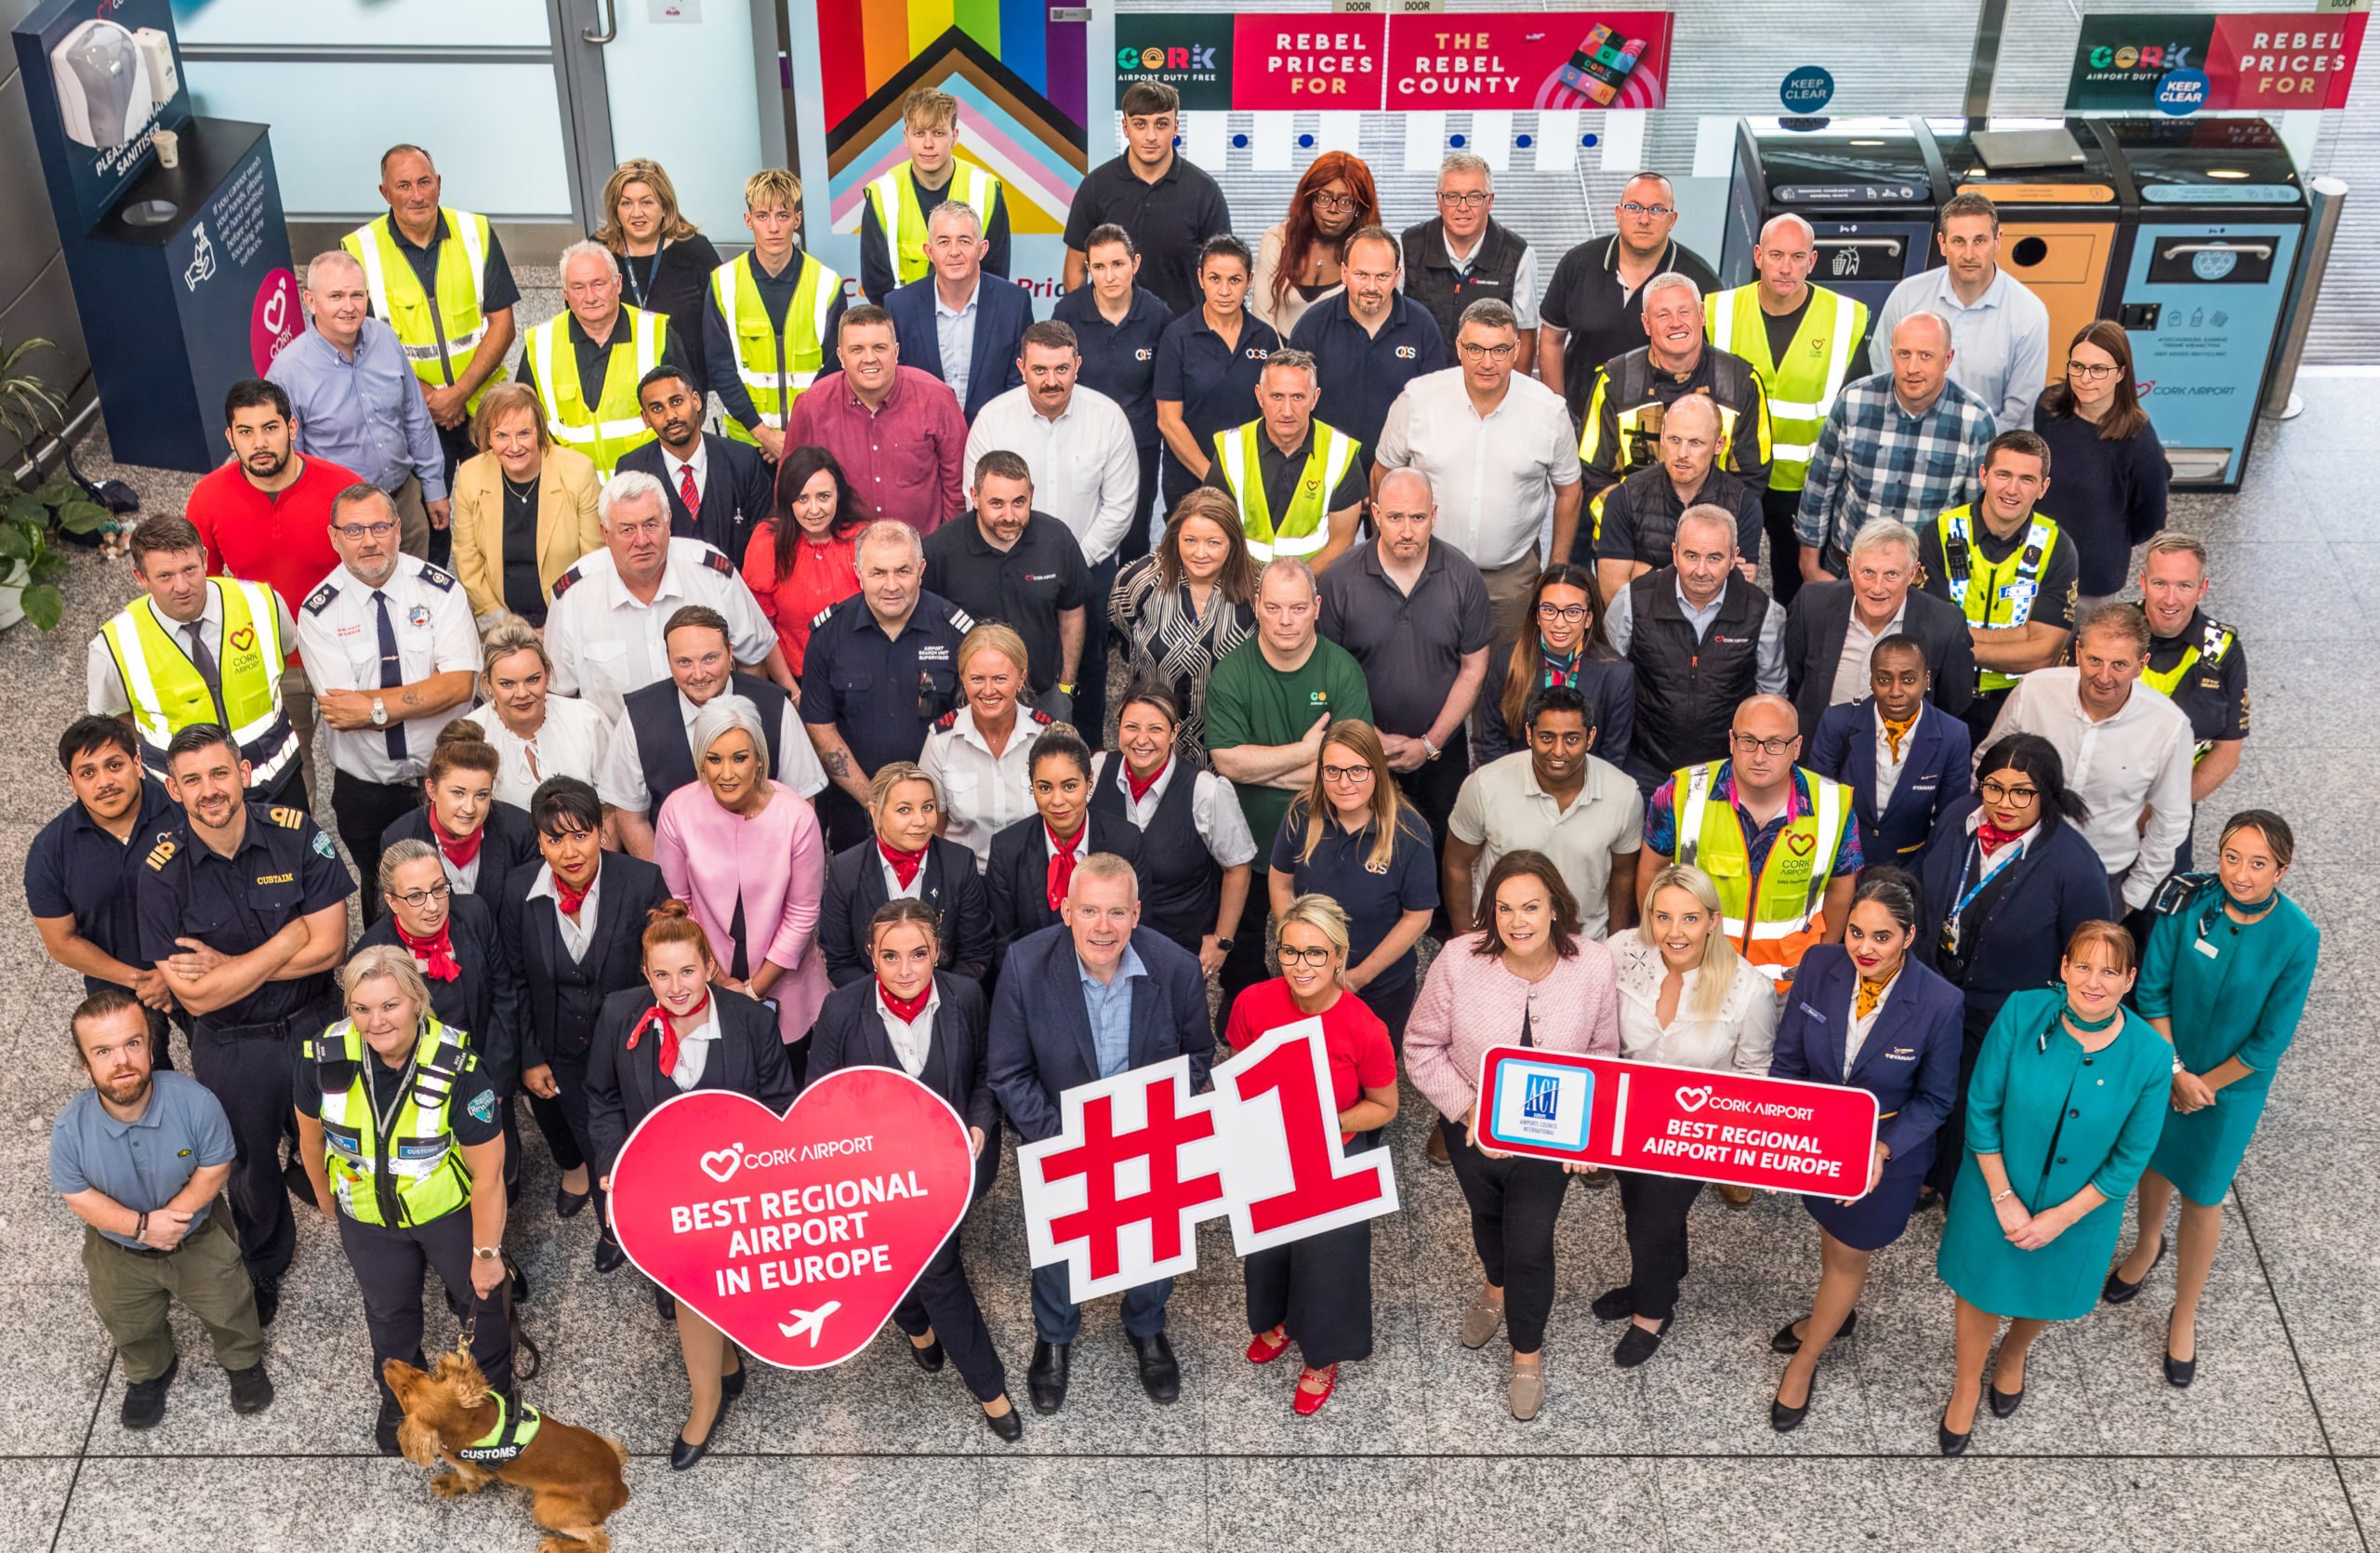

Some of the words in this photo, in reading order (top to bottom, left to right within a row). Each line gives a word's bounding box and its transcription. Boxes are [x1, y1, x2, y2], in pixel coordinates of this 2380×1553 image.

[1346, 2, 1371, 12] DOOR
[1405, 1, 1430, 11] DOOR
[1276, 33, 1367, 50] REBEL
[1435, 33, 1489, 50] THE
[2253, 33, 2345, 49] REBEL
[1117, 44, 1216, 70] CORK
[1267, 56, 1373, 73] PRICES
[1416, 56, 1505, 73] REBEL
[2089, 43, 2191, 69] CORK
[2240, 55, 2346, 73] PRICES
[1117, 73, 1159, 82] AIRPORT
[1163, 73, 1189, 82] DUTY
[1193, 73, 1216, 82] FREE
[1290, 77, 1347, 94] FOR
[1397, 76, 1521, 95] COUNTY
[1791, 79, 1824, 89] KEEP
[2086, 73, 2130, 81] AIRPORT
[2132, 73, 2159, 81] DUTY
[2258, 77, 2316, 94] FOR
[1785, 89, 1828, 100] CLEAR
[2166, 81, 2202, 91] KEEP
[2160, 91, 2202, 103] CLEAR
[218, 193, 230, 211] you
[228, 171, 247, 198] cannot
[246, 155, 261, 176] wash
[216, 210, 229, 231] your
[246, 170, 263, 195] please
[219, 225, 231, 242] use
[230, 206, 244, 229] hand
[227, 226, 245, 251] before
[251, 202, 263, 222] after
[270, 324, 293, 360] CORK
[1246, 348, 1268, 360] OCS
[2152, 386, 2187, 395] CORK
[2188, 386, 2236, 395] AIRPORT
[232, 652, 258, 667] CORK
[234, 660, 260, 676] AIRPORT
[1779, 868, 1809, 876] AIRPORT
[1782, 859, 1811, 869] CORK
[257, 873, 294, 885] CUSTAIM
[1526, 1077, 1558, 1114] ACI
[1709, 1096, 1752, 1113] CORK
[1752, 1102, 1814, 1122] AIRPORT
[1666, 1119, 1718, 1140] BEST
[1721, 1125, 1823, 1154] REGIONAL
[744, 1147, 797, 1170] CORK
[800, 1135, 874, 1161] AIRPORT
[1040, 1036, 1382, 1281] #1
[1642, 1136, 1731, 1162] AIRPORT
[1733, 1148, 1757, 1167] IN
[1760, 1152, 1843, 1178] EUROPE
[670, 1196, 751, 1234] BEST
[760, 1170, 929, 1220] REGIONAL
[728, 1211, 869, 1258] AIRPORT
[715, 1267, 751, 1296] IN
[760, 1244, 892, 1291] EUROPE
[460, 1446, 517, 1459] CUSTOMS
